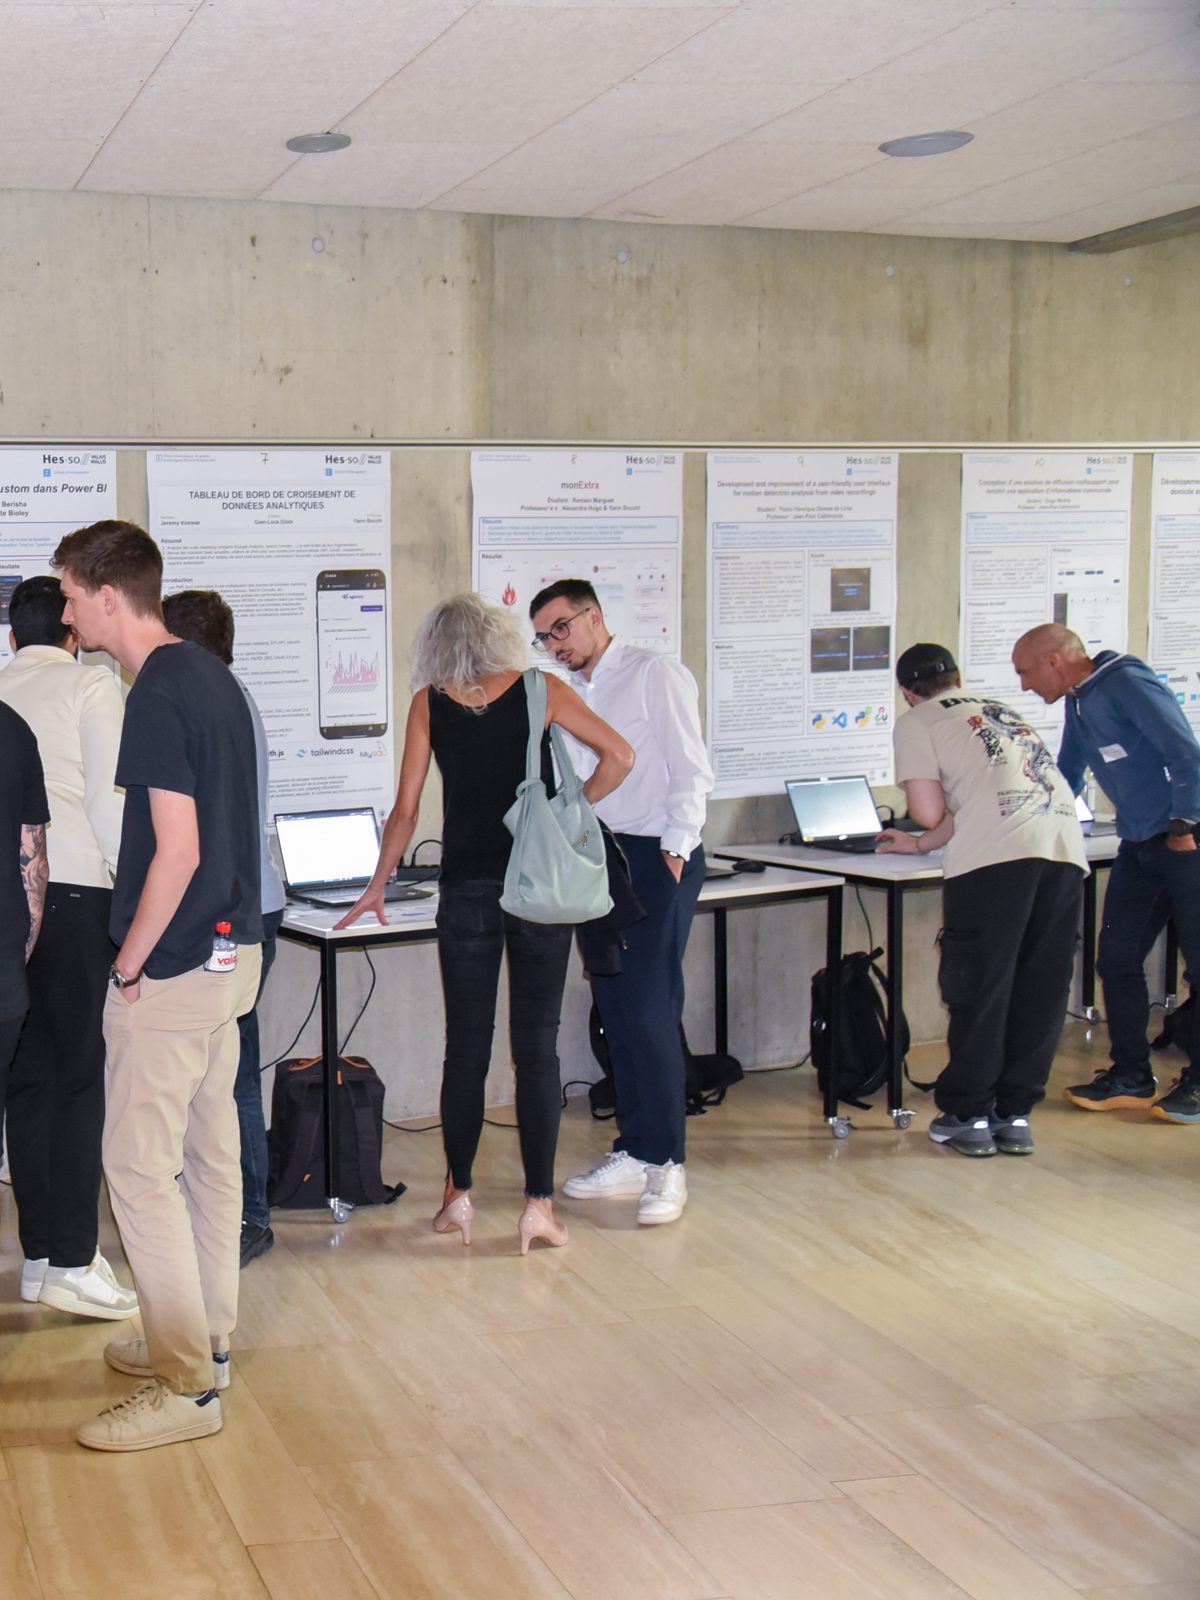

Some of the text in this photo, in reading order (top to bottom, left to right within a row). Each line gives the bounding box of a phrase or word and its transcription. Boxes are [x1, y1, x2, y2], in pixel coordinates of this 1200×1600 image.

[260, 453, 270, 465] 7
[560, 480, 599, 489] monExtra
[817, 479, 851, 487] user-friendly
[1160, 478, 1200, 486] Développeme
[33, 483, 57, 493] dans
[61, 483, 93, 493] Power
[96, 483, 107, 492] BI
[189, 490, 229, 499] TABLEAU
[245, 490, 270, 498] BORD
[272, 490, 284, 498] DE
[286, 490, 341, 498] CROISEMENT
[344, 490, 355, 498] DE
[222, 500, 324, 511] DONNÉES ANALYTIQUES
[8, 509, 28, 517] Bioley
[311, 747, 354, 757] tailwindcss
[360, 749, 385, 759] MySQL
